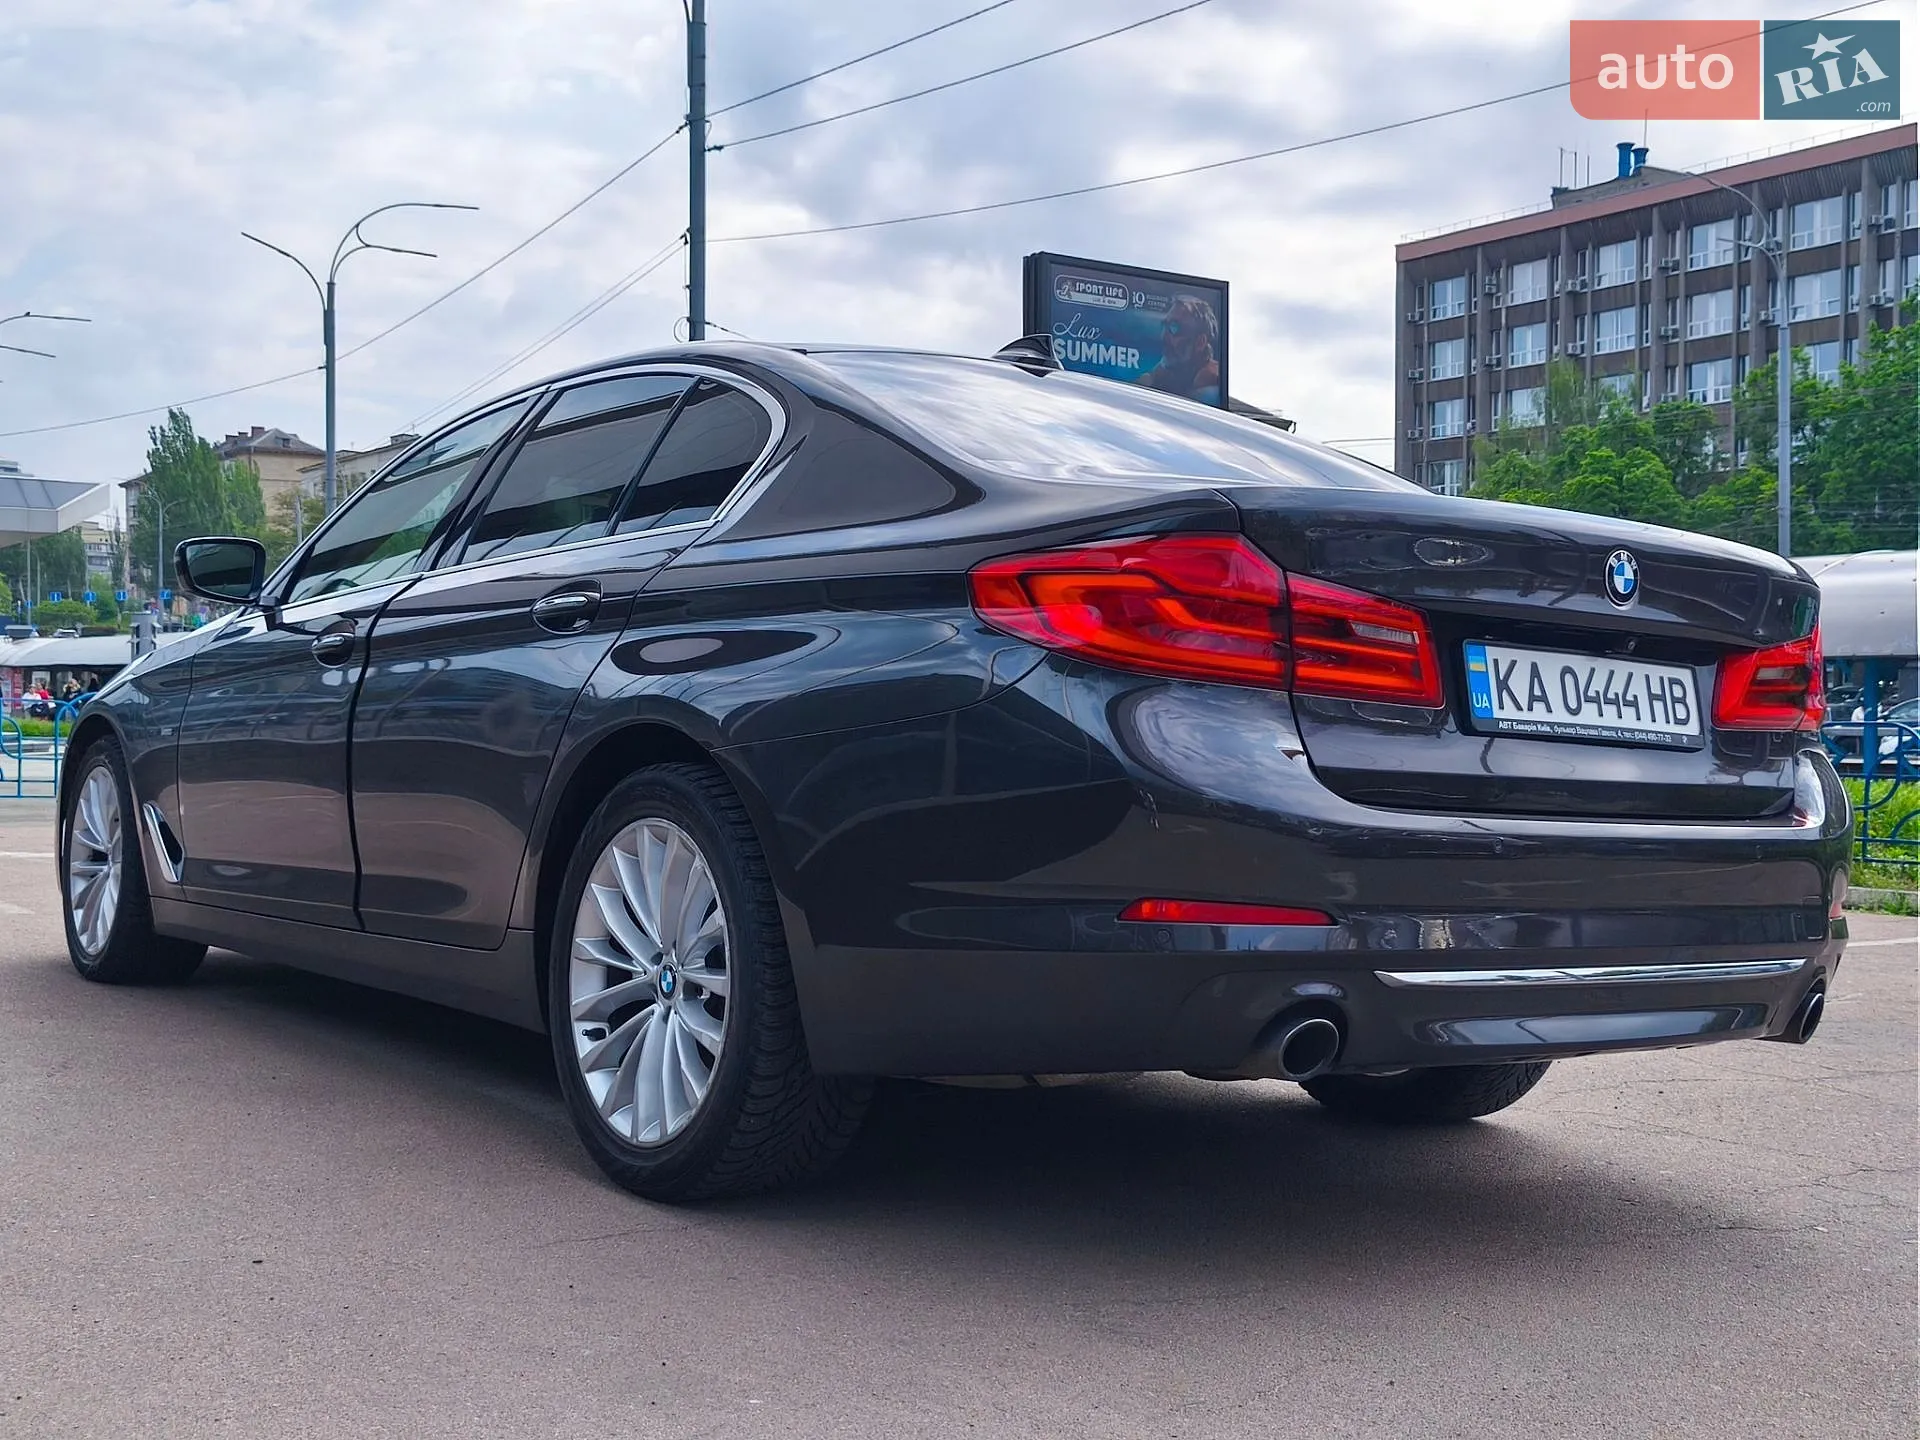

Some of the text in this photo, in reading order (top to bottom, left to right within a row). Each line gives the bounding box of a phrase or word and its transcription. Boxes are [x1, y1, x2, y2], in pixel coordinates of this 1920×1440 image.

[1075, 281, 1123, 298] SPORT LIFE
[1052, 312, 1102, 340] Lux
[1053, 338, 1140, 369] SUMMER
[1472, 691, 1490, 709] UA
[1493, 658, 1691, 726] KA 0444 HB
